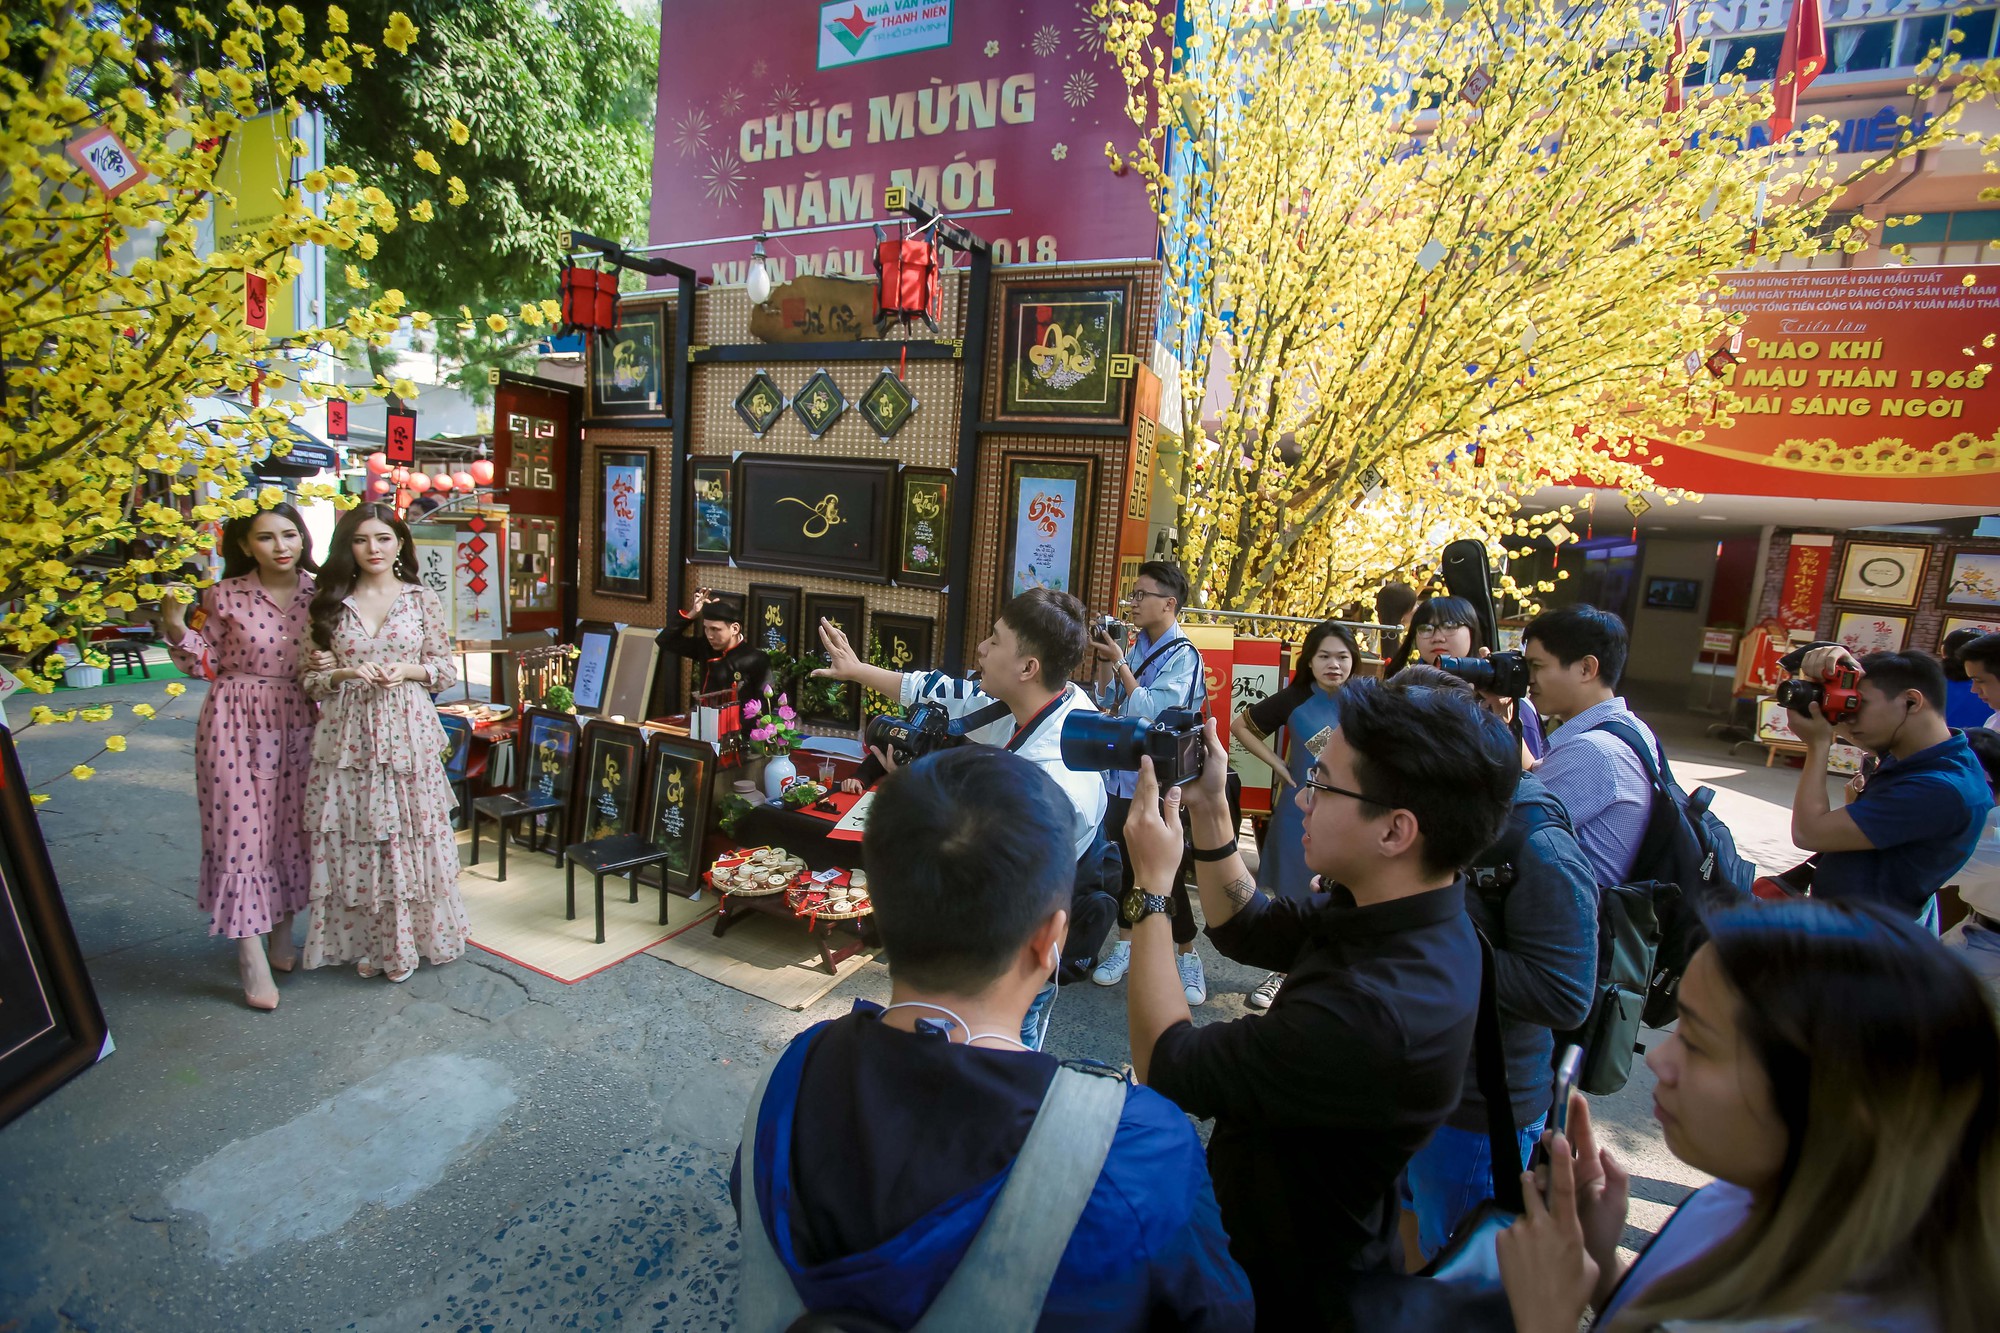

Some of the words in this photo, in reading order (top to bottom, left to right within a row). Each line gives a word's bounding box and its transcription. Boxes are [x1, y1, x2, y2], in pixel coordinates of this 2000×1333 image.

[867, 3, 889, 17] NHÀ
[881, 11, 918, 28] THANH
[922, 5, 947, 20] NIÊN
[739, 99, 853, 163] CHÚC
[867, 73, 1036, 144] MỪNG
[762, 170, 876, 231] NĂM
[712, 255, 786, 286] XUN
[991, 234, 1058, 266] 018
[1727, 277, 1755, 288] CHÀO
[1858, 273, 1882, 285] ĐÁN
[1912, 271, 1943, 284] TUẤT
[1757, 289, 1786, 299] NGÀY
[1787, 289, 1824, 299] THÀNH
[1941, 285, 1967, 297] VIỆT
[1968, 286, 1997, 296] NAM
[1816, 300, 1847, 311] CÔNG
[1849, 300, 1863, 310] VÀ
[1912, 299, 1945, 309] XUÂN
[1977, 298, 2000, 308] THÂ
[1757, 338, 1819, 360] HÀO
[1828, 337, 1884, 359] KHÍ
[1742, 365, 1808, 391] MẬU
[1817, 366, 1898, 388] THÂN
[1910, 369, 1986, 389] 1968
[1789, 394, 1872, 416] SÁNG
[1879, 395, 1964, 418] NGỜI
